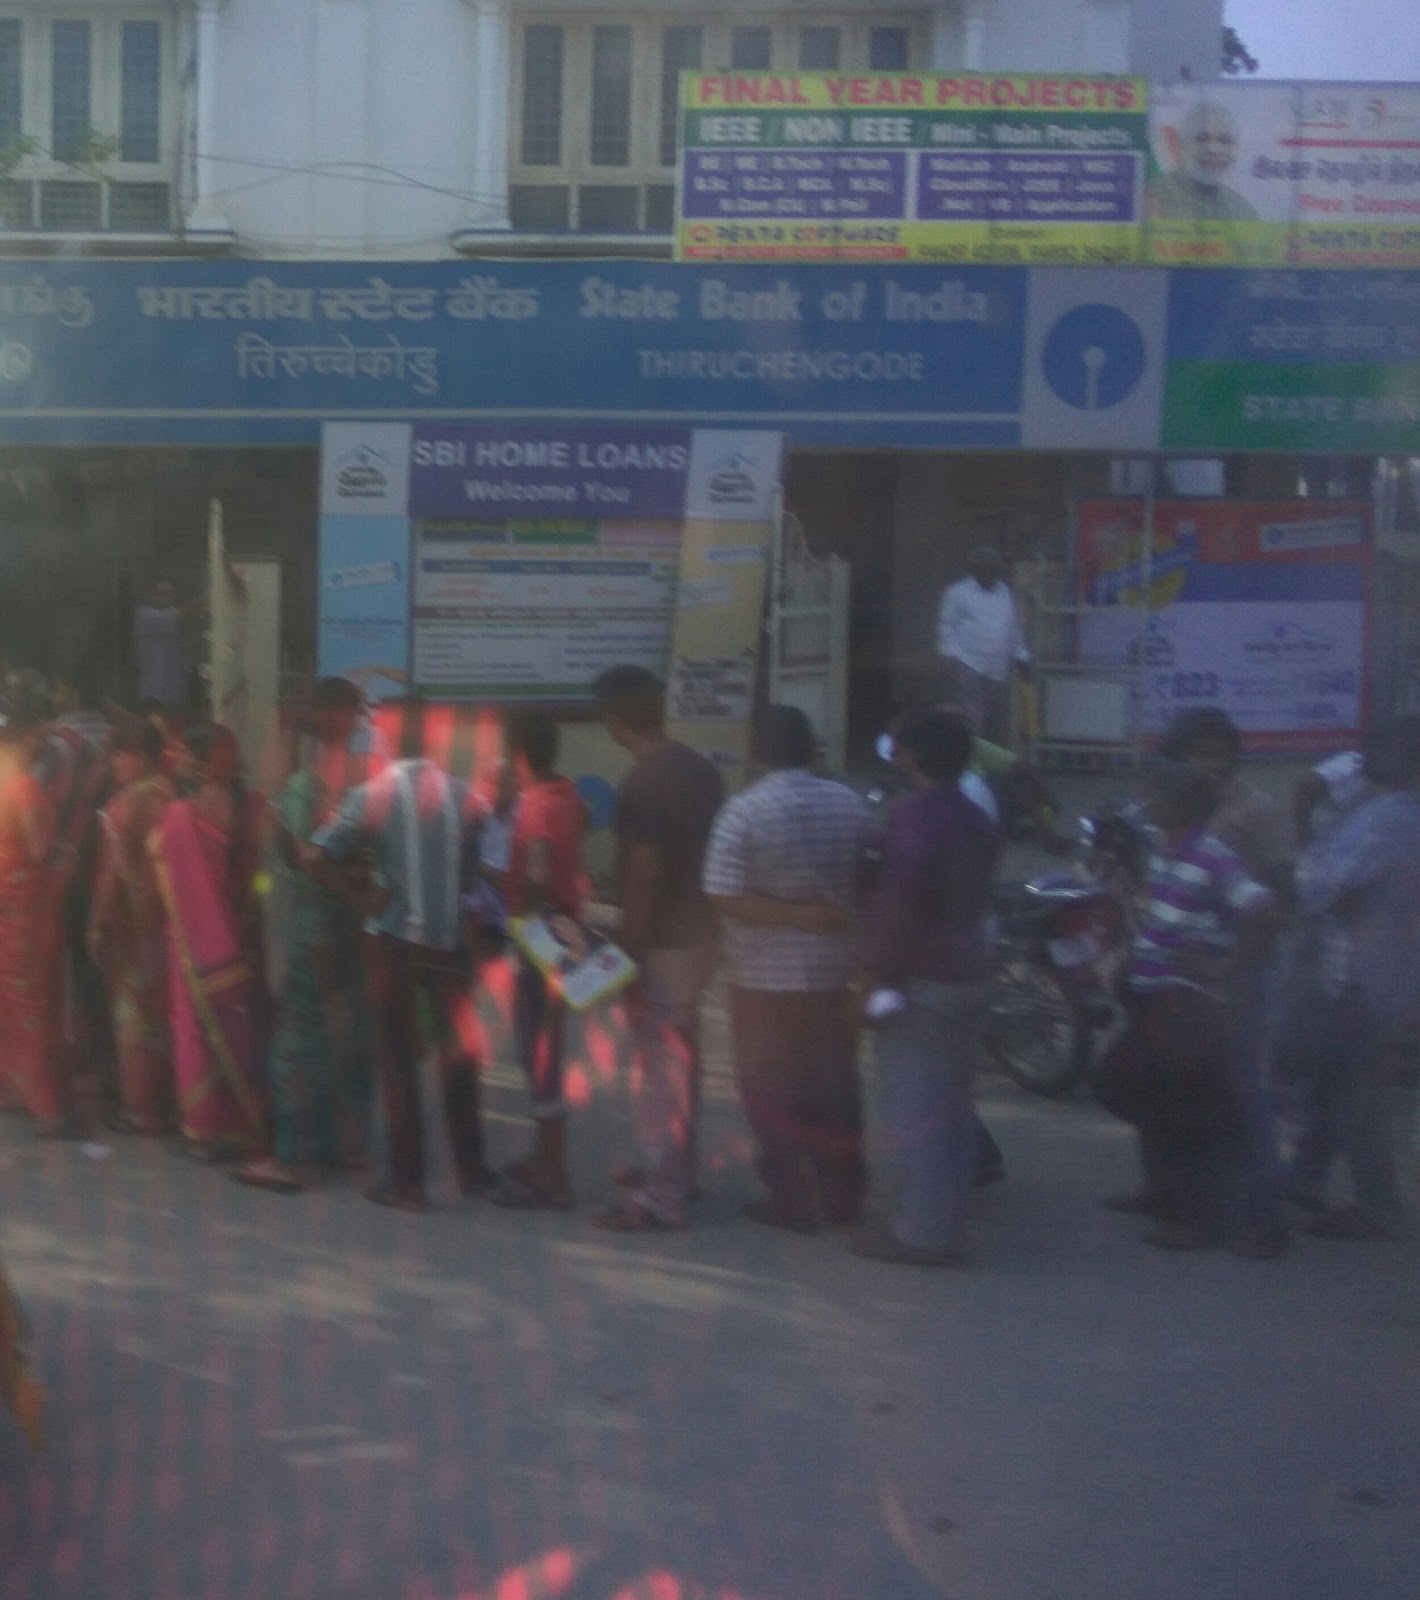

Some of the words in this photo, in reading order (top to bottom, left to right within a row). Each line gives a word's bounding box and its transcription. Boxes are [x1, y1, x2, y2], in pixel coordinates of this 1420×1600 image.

[700, 77, 808, 104] FINAL
[825, 78, 924, 105] YEAR
[936, 79, 1136, 108] PROJECTS
[700, 116, 761, 142] IEEE
[784, 117, 841, 142] NON
[851, 117, 912, 142] IEEE
[1048, 124, 1134, 149] Projects
[136, 275, 314, 320] भारतीय
[319, 277, 438, 320] स्टेट
[445, 275, 540, 320] बैंक
[579, 277, 681, 319] State
[701, 279, 801, 321] Bank
[823, 281, 867, 320] of
[884, 281, 988, 321] India
[639, 349, 925, 381] THIRUCHENGODE
[1242, 396, 1342, 422] STATE
[412, 440, 465, 467] SBI
[474, 440, 570, 467] HOME
[577, 443, 688, 471] LOANS
[464, 480, 577, 501] Welcome
[582, 480, 631, 503] You
